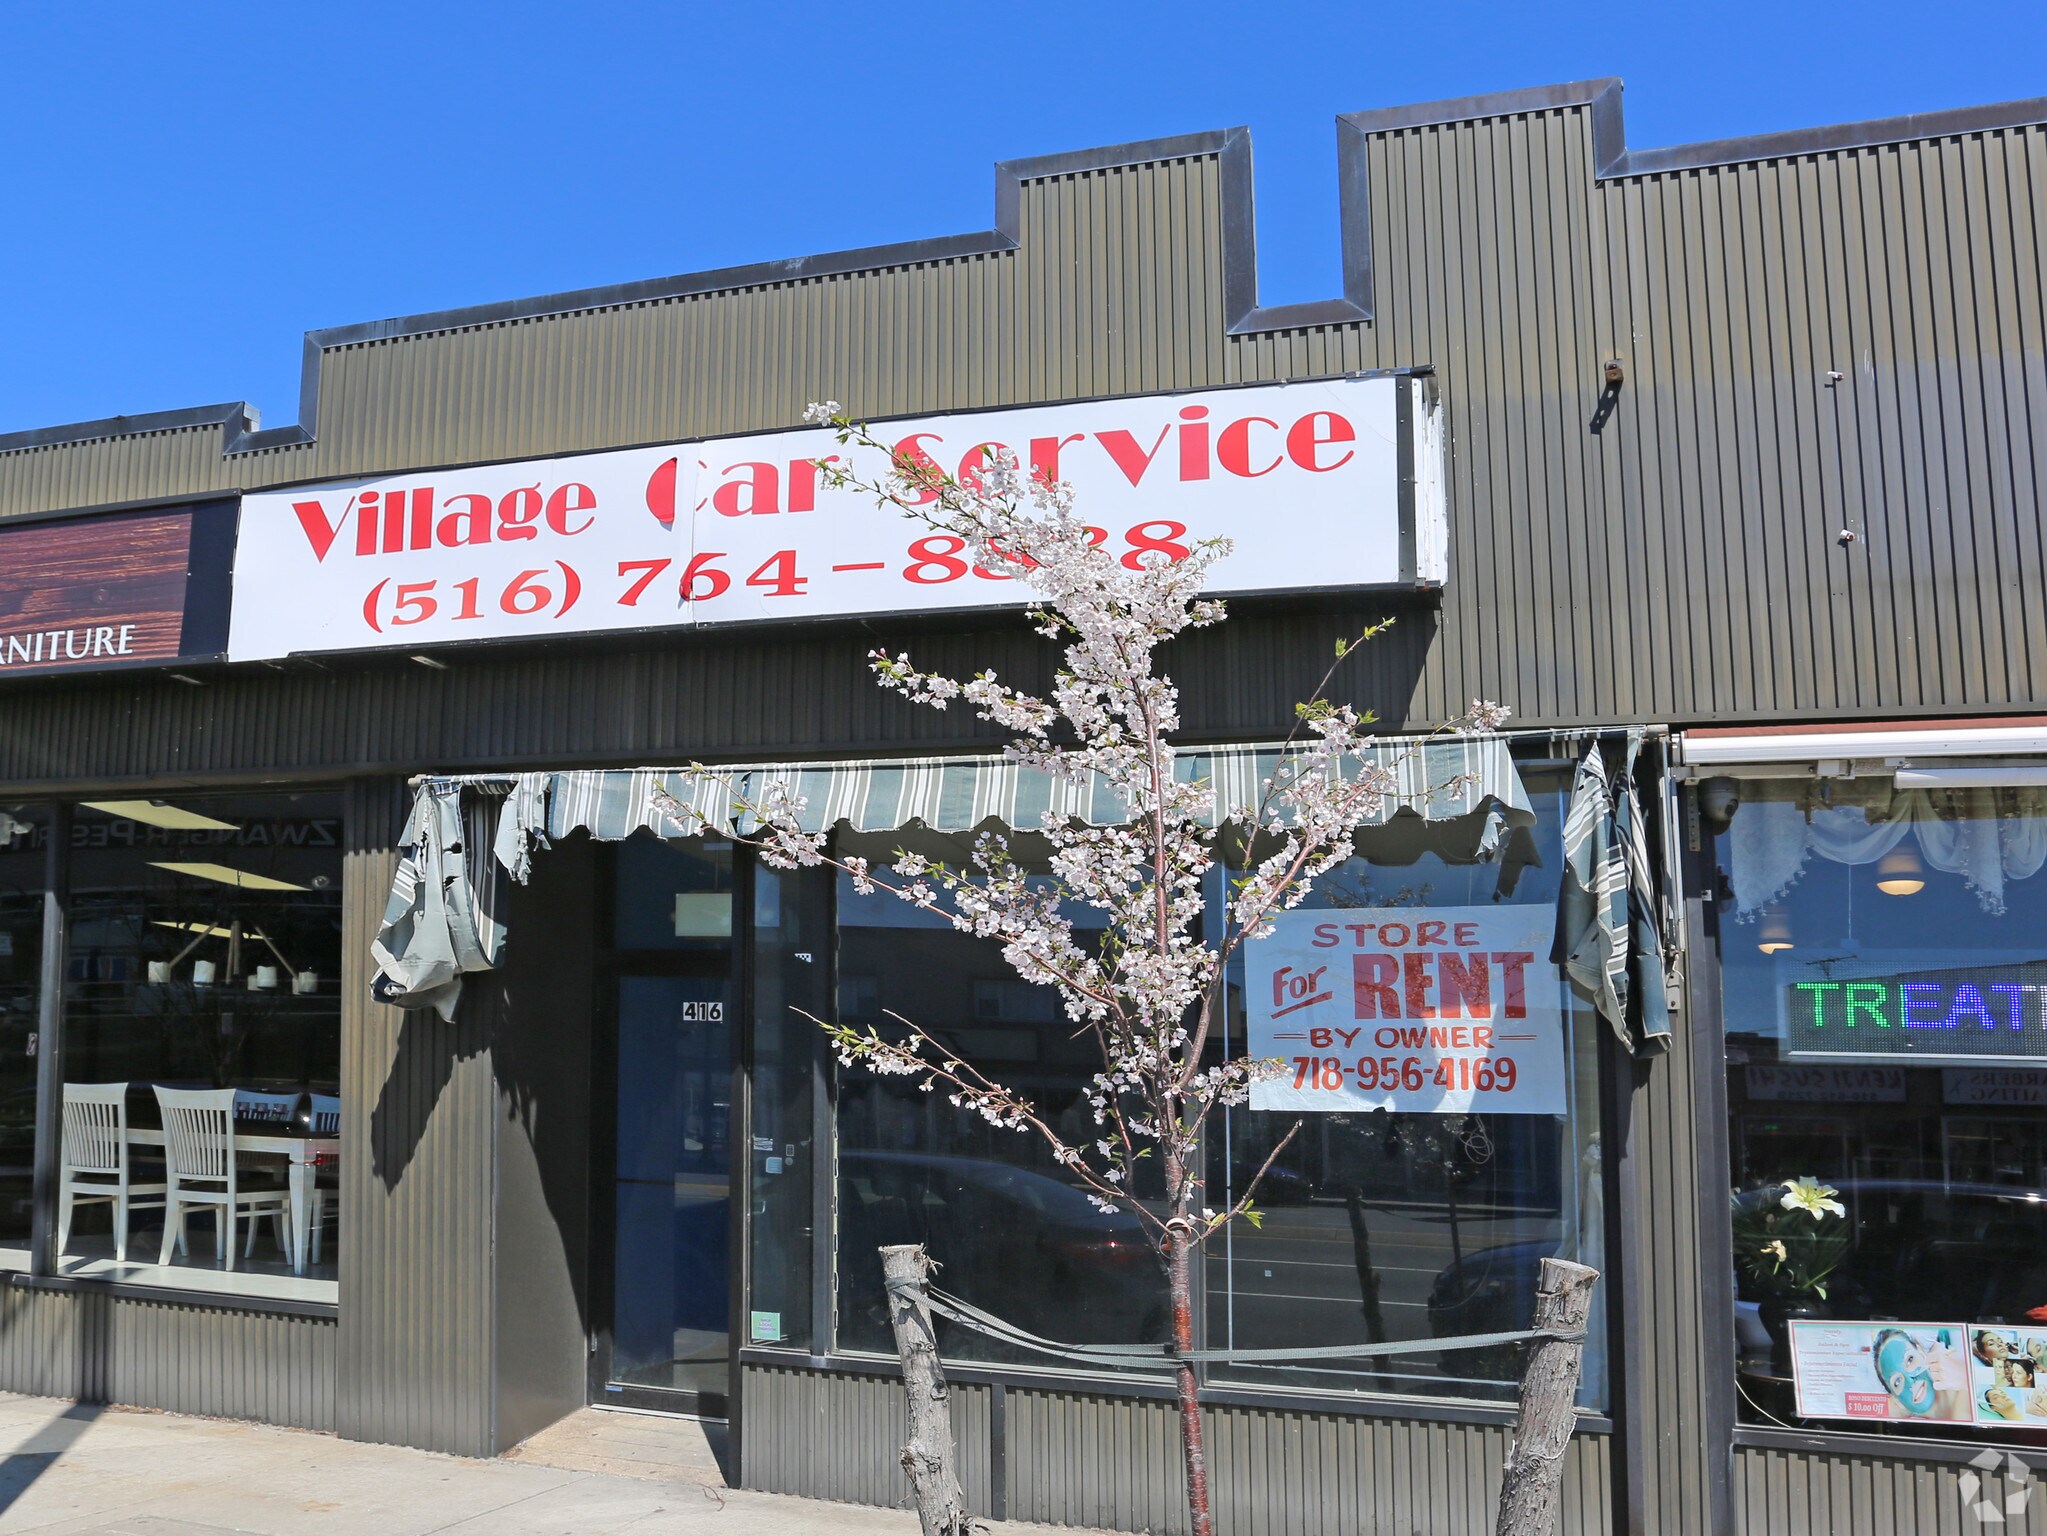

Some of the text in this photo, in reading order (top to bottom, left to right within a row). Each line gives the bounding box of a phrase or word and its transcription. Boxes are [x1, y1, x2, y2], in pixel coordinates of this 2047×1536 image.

[292, 404, 1356, 563] Village Car Service
[363, 519, 1191, 633] (516) 764-888
[1311, 921, 1480, 948] STORE
[1272, 951, 1534, 1020] For RENT
[684, 1003, 722, 1020] 416
[1797, 983, 2047, 1031] TREAT
[1309, 1026, 1496, 1049] BY OWNER
[1292, 1056, 1517, 1092] 718-956-4169
[1872, 1403, 1885, 1414] Off
